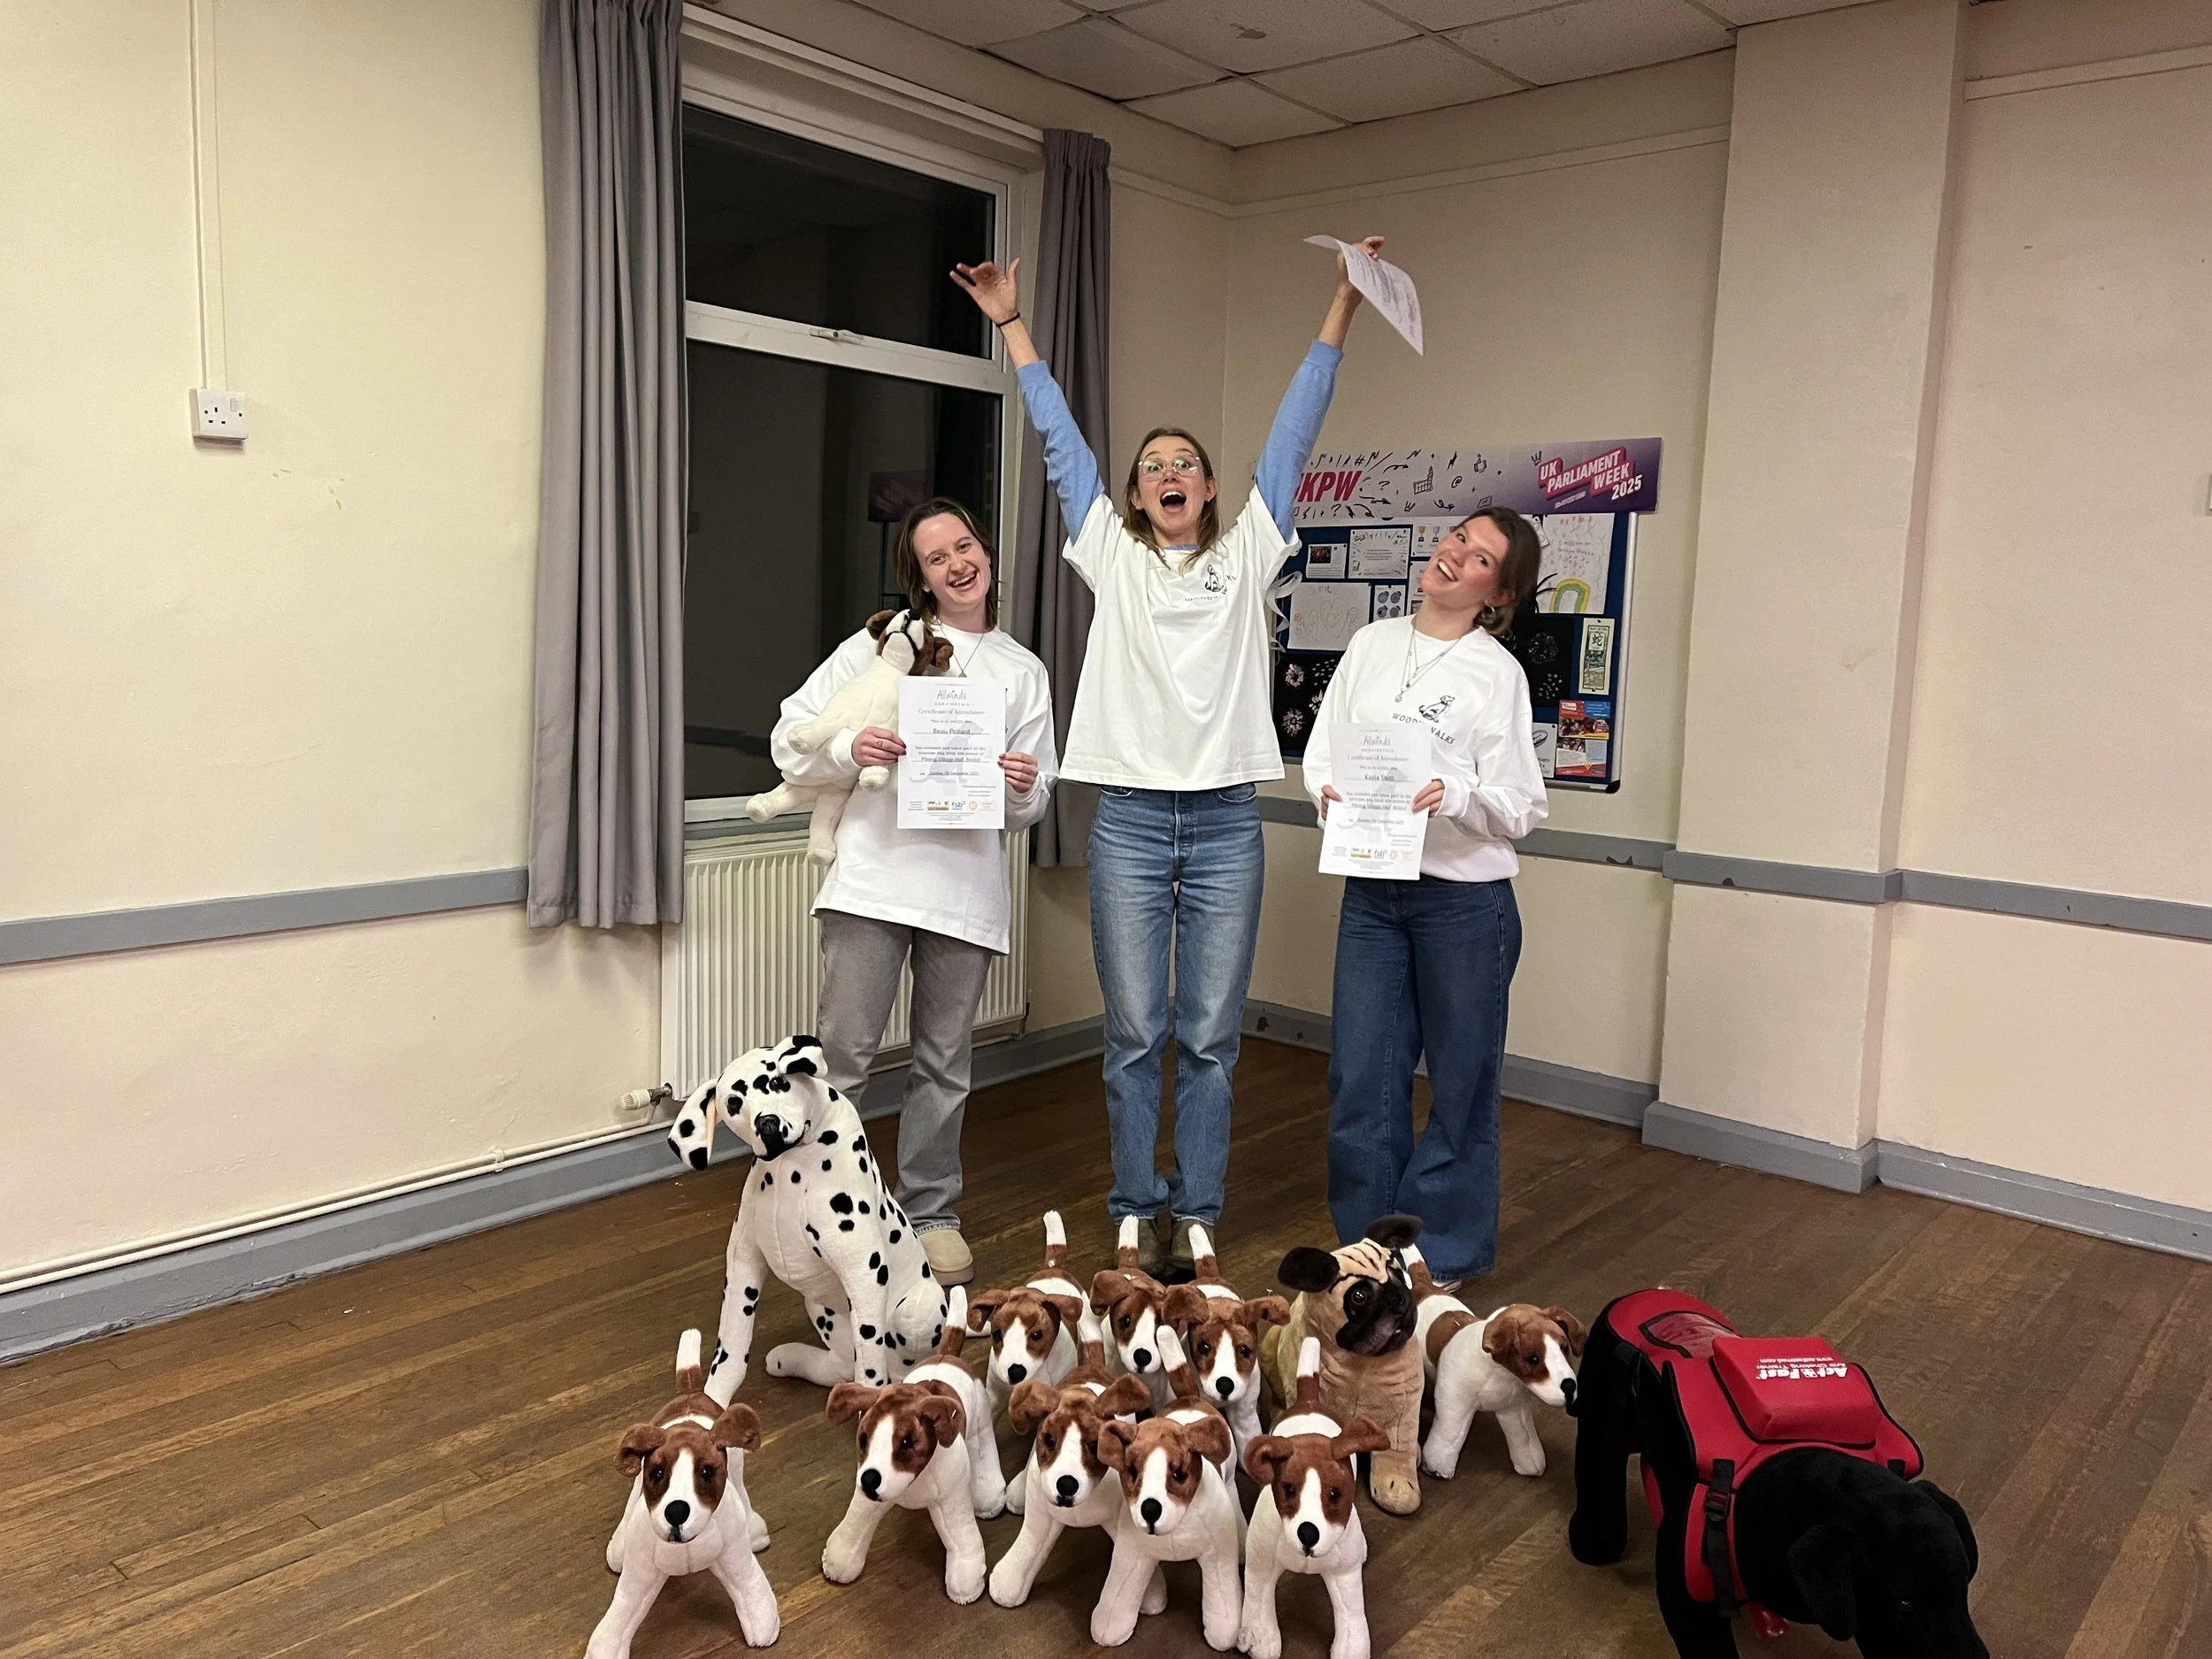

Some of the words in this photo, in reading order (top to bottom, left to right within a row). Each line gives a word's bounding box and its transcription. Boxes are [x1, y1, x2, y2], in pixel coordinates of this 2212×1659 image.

[1540, 460, 1558, 480] UK
[1547, 449, 1621, 493] PARLIAMENT
[1594, 462, 1630, 490] WEEK
[1611, 474, 1643, 501] 2025
[1759, 1368, 1801, 1380] Fast
[1816, 1367, 1847, 1378] Act
